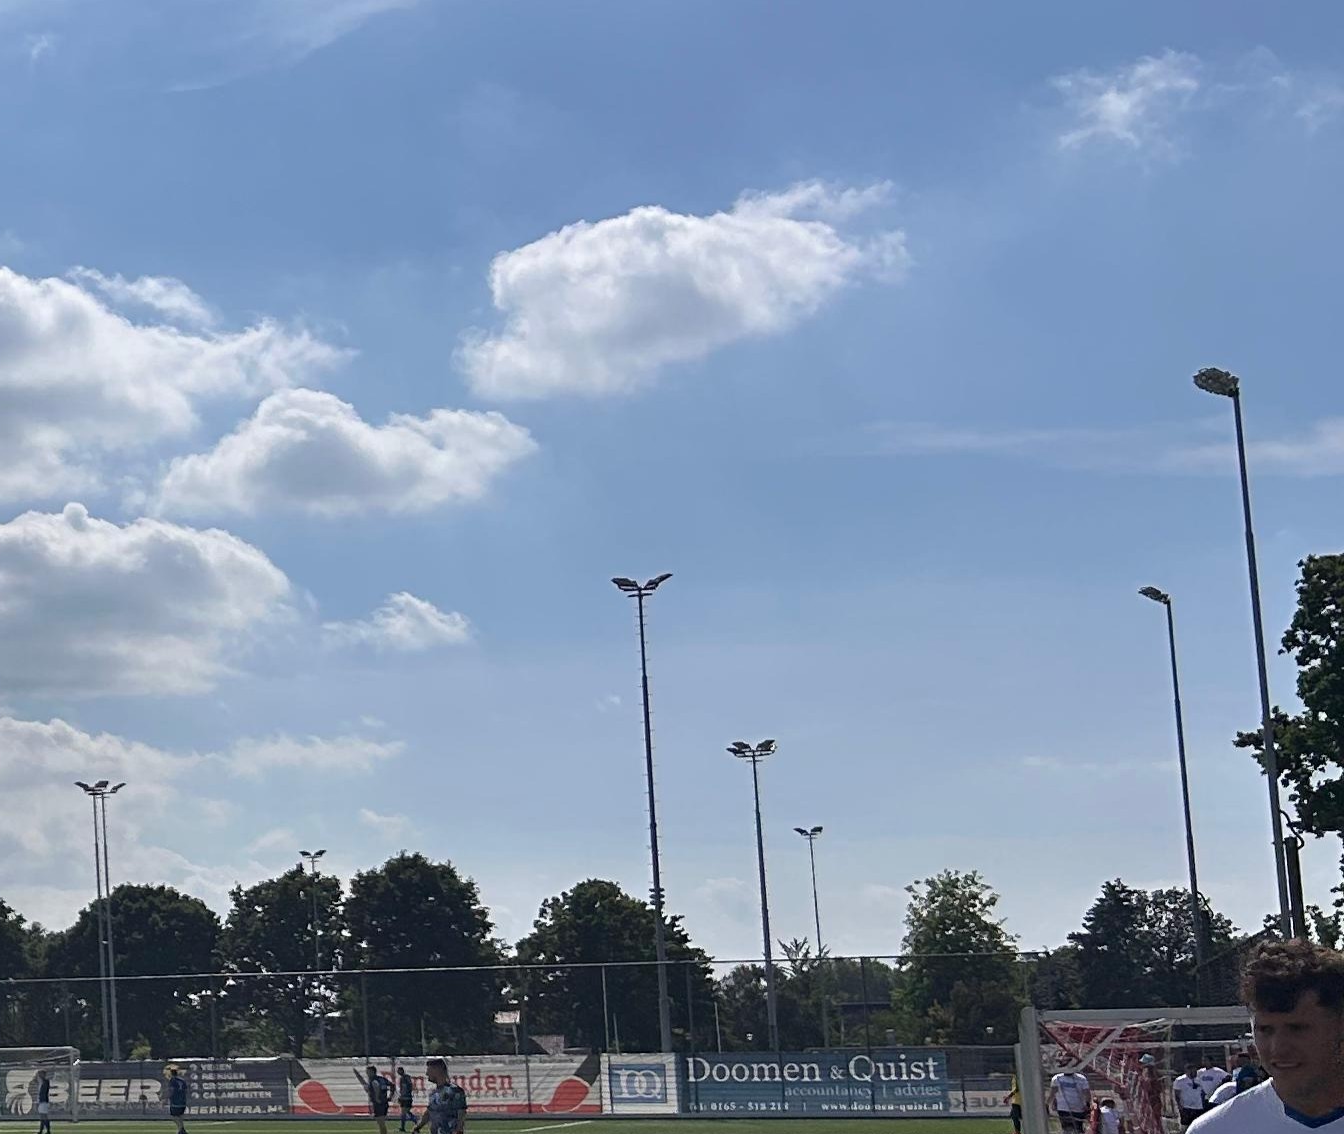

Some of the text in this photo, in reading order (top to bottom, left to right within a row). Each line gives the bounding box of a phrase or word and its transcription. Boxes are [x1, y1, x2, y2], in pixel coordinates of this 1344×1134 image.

[686, 1054, 940, 1083] Doomen & Quist
[784, 1085, 872, 1098] accountancy
[894, 1082, 942, 1097] advies
